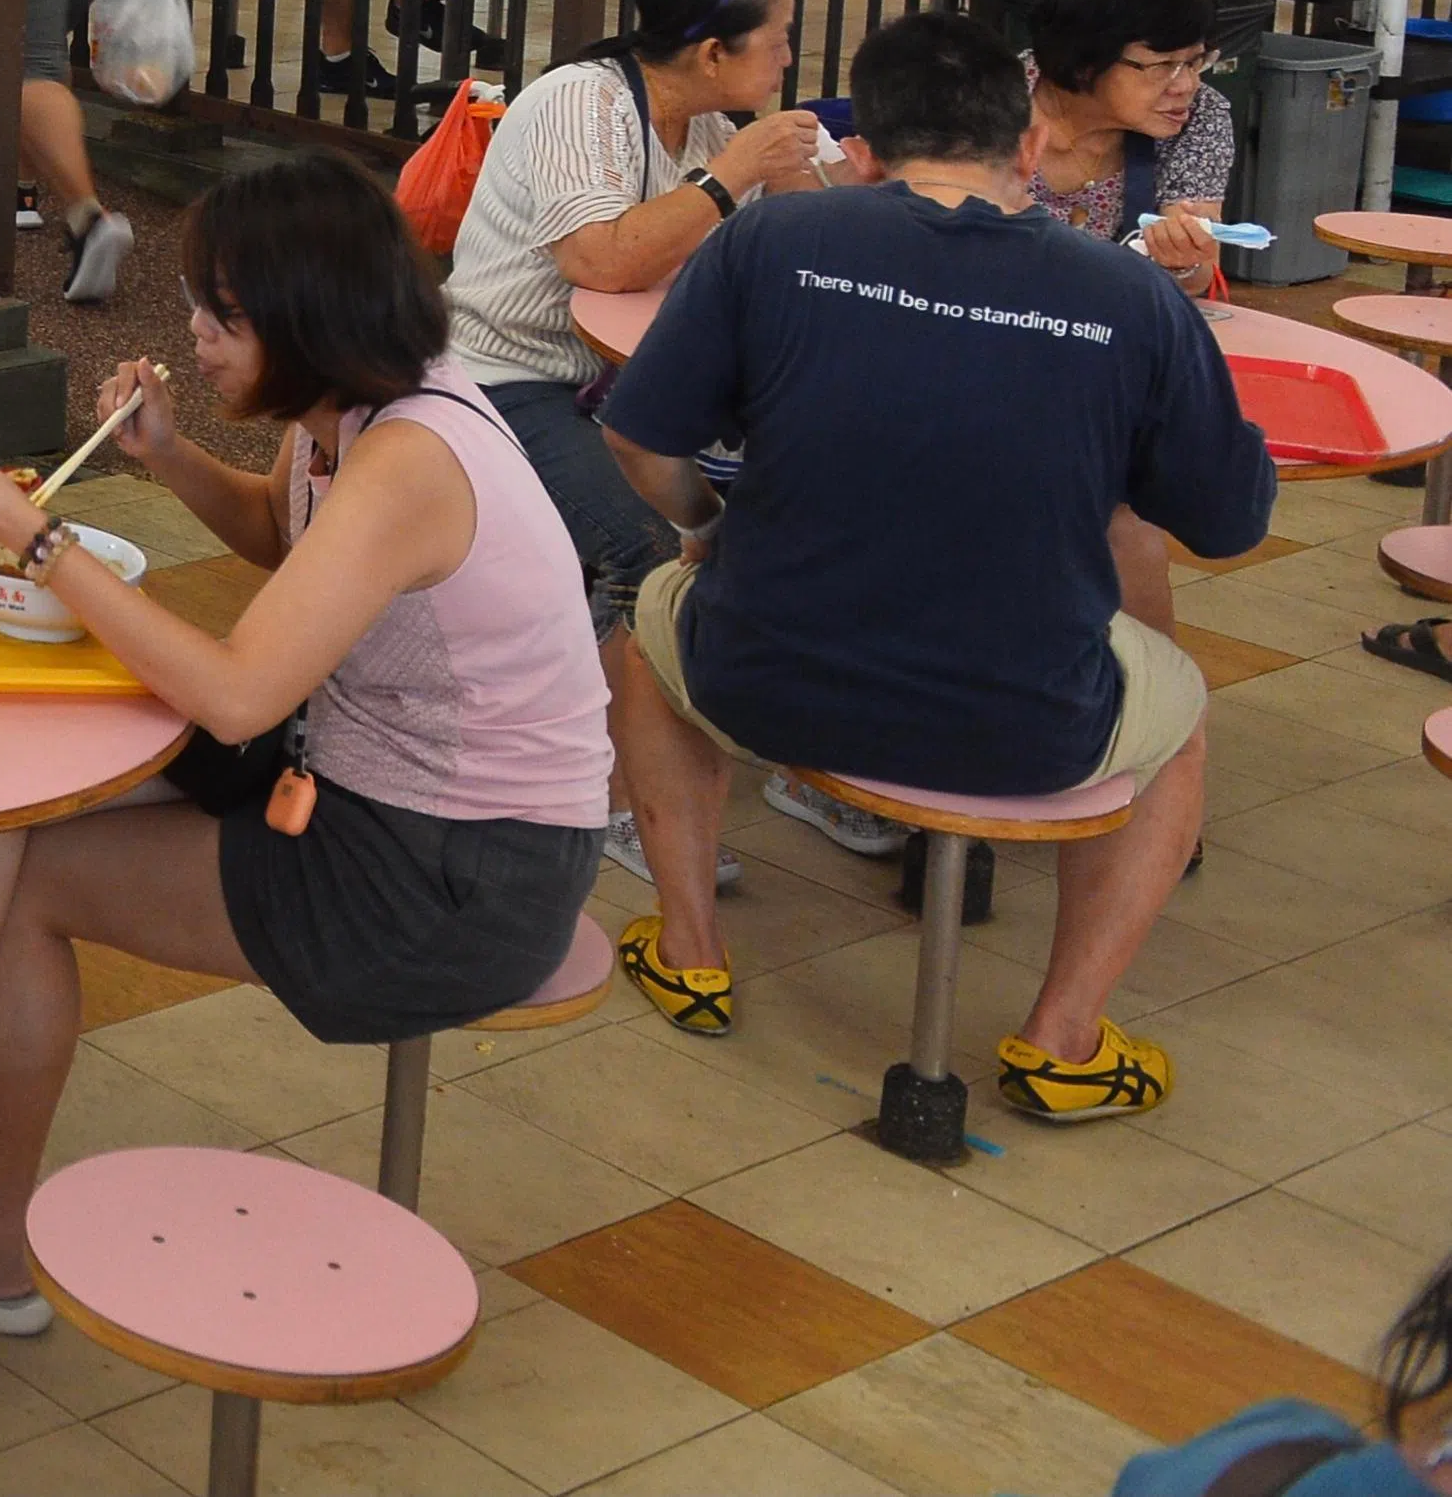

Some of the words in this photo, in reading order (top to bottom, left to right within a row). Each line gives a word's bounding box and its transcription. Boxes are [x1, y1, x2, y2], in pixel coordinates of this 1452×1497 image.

[796, 269, 853, 293] There
[857, 282, 894, 303] will
[899, 289, 929, 311] be
[934, 302, 964, 318] no
[969, 304, 1068, 337] standing
[1071, 320, 1113, 345] still!
